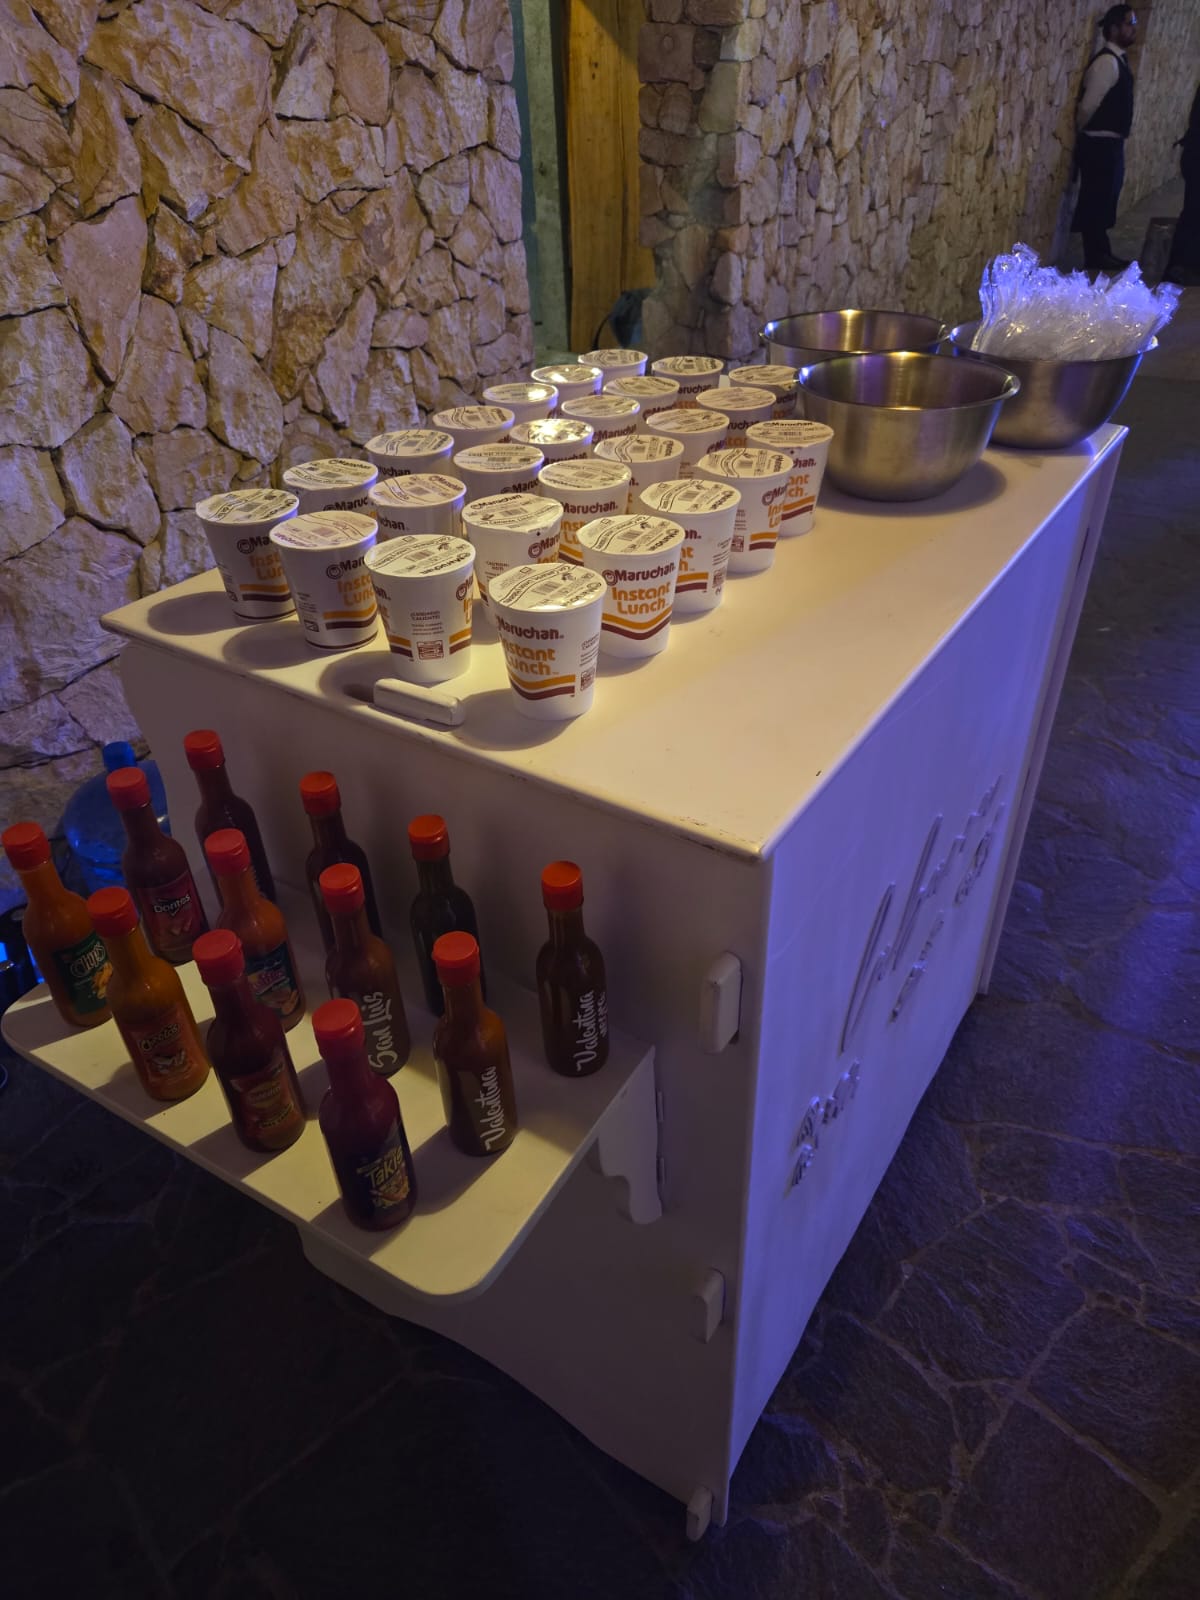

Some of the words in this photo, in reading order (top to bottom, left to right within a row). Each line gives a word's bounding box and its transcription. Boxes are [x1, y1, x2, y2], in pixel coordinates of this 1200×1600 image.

[563, 501, 616, 515] Maruchan
[615, 562, 675, 582] Maruchan
[611, 581, 671, 601] Instant
[617, 598, 666, 615] Lunch
[496, 615, 560, 640] Maruchan
[572, 990, 597, 1071] Valentina
[475, 1066, 506, 1151] Valentina
[363, 1145, 403, 1189] Takis
